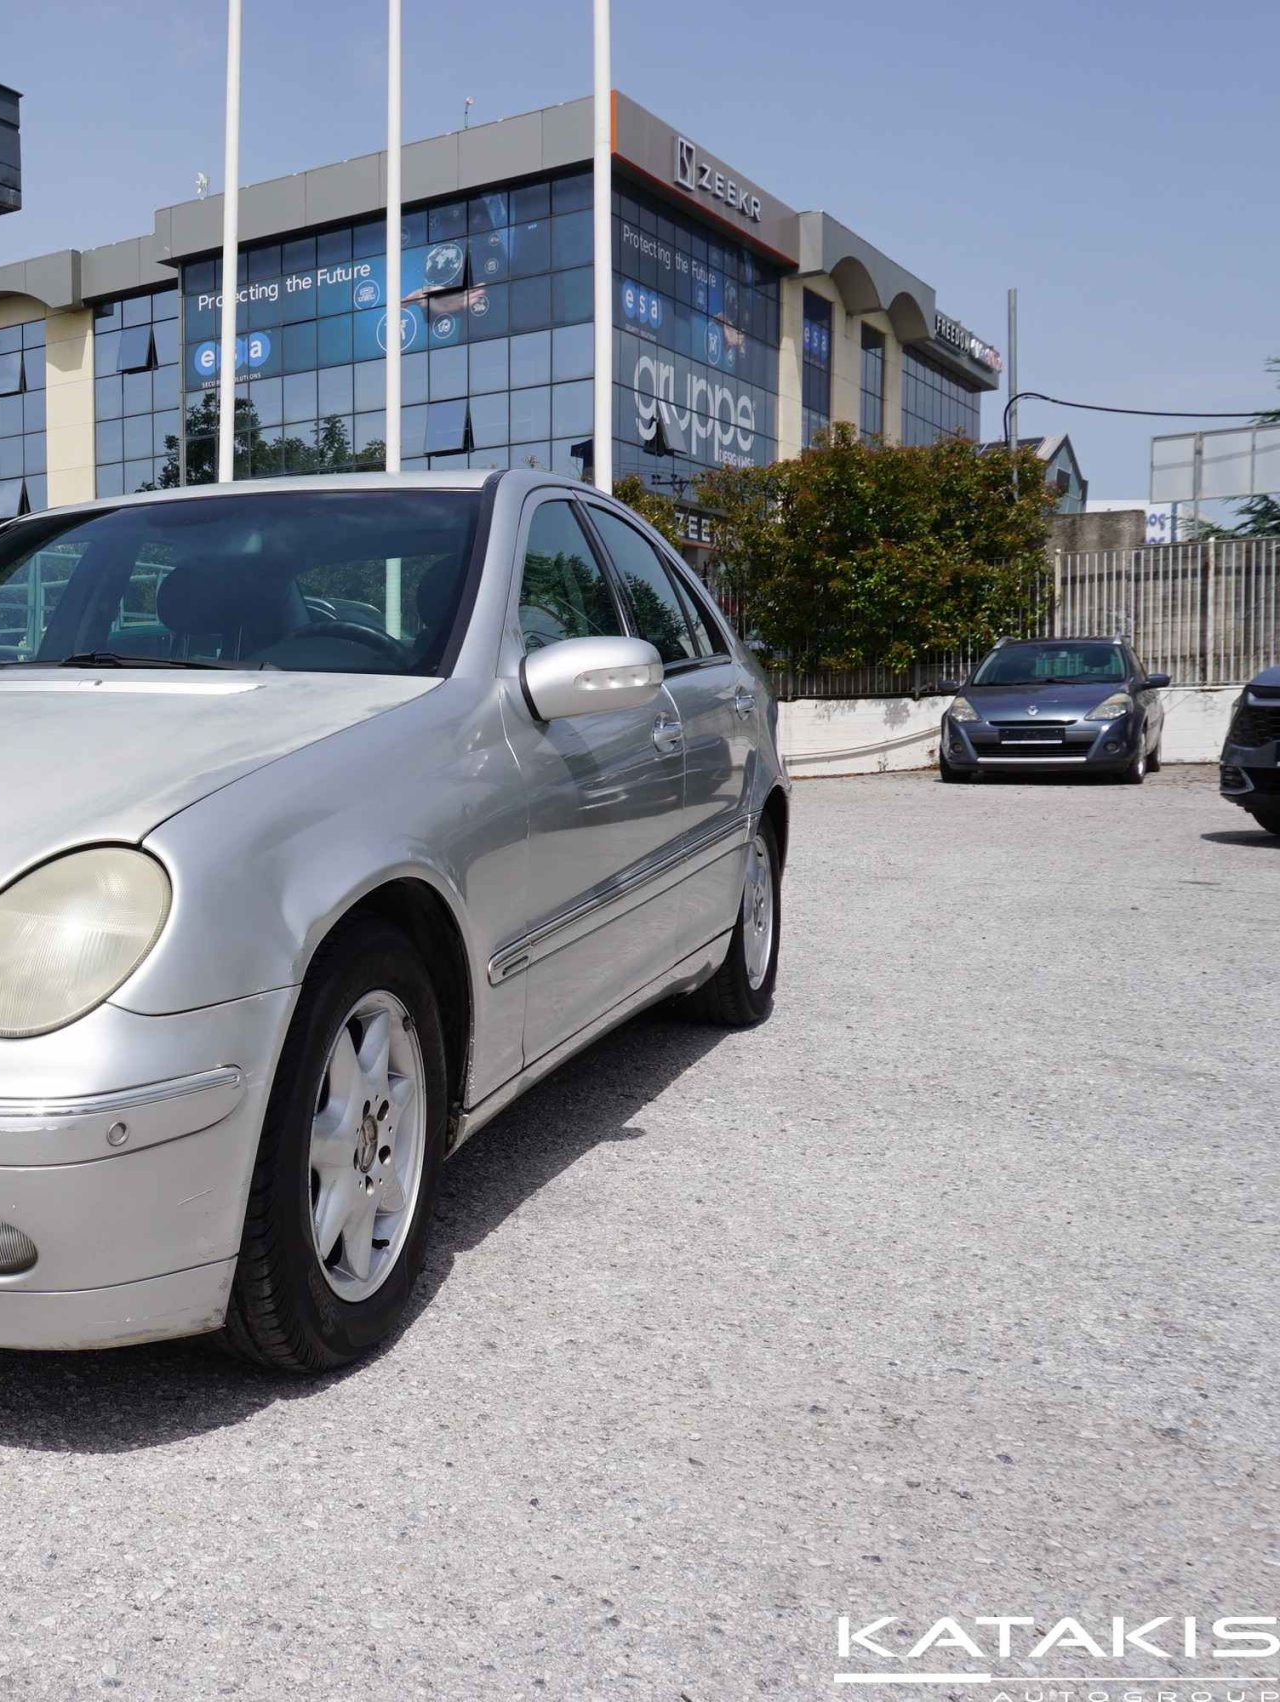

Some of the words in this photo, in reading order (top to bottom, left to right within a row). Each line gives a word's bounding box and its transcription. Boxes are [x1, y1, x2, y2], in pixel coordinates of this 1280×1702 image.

[697, 163, 761, 221] ZEEKR
[623, 224, 671, 270] Protecting
[675, 252, 689, 274] the
[691, 260, 717, 288] Future
[198, 283, 279, 311] Procting
[285, 275, 313, 293] the
[317, 264, 372, 287] Future
[625, 288, 658, 320] esa
[200, 339, 262, 368] ea
